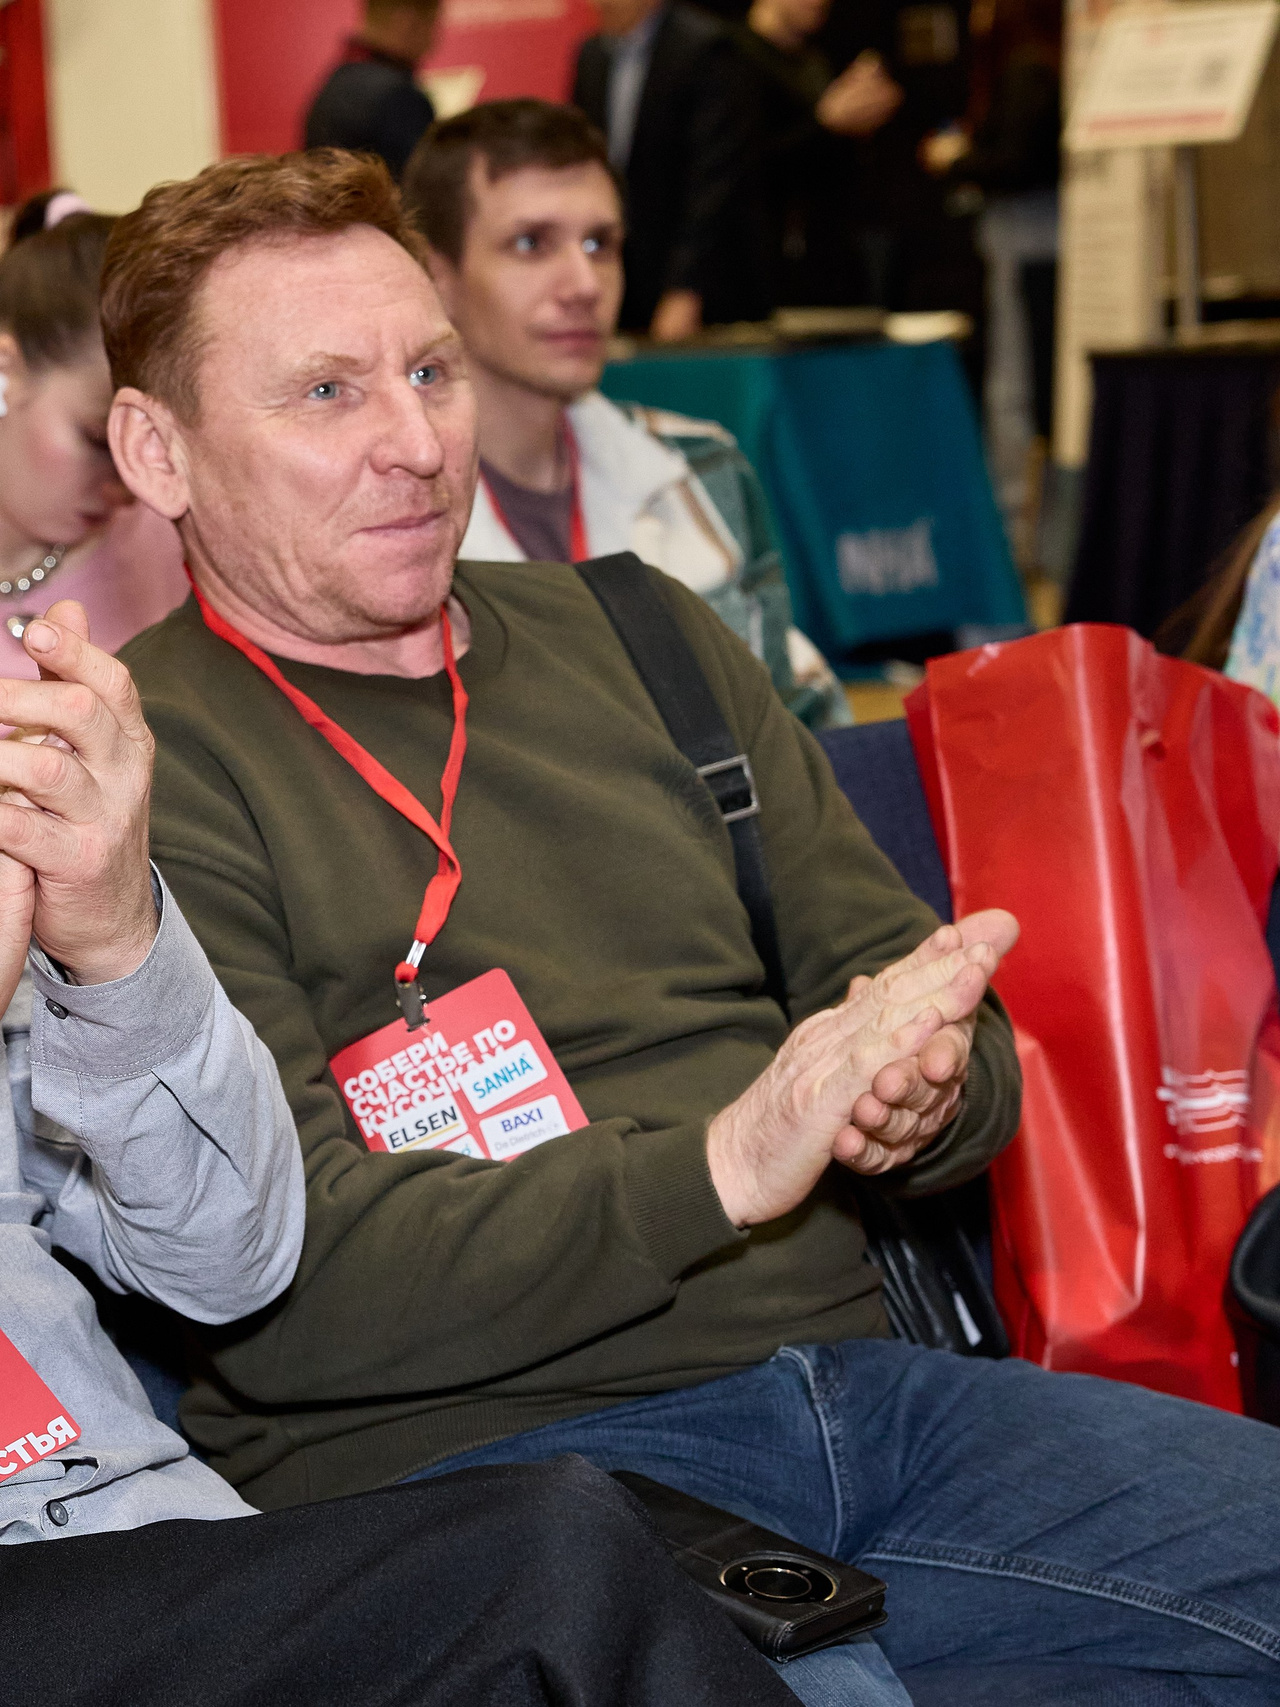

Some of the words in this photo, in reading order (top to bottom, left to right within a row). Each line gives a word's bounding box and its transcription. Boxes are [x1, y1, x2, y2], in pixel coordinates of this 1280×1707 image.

[344, 1031, 449, 1100] СОБЕРИ
[352, 1041, 471, 1119] СЧАСТЬЕ
[473, 1019, 517, 1054] ПО
[473, 1056, 534, 1100] SANHA
[388, 1105, 459, 1150] ELSEN
[500, 1107, 544, 1134] BAXI
